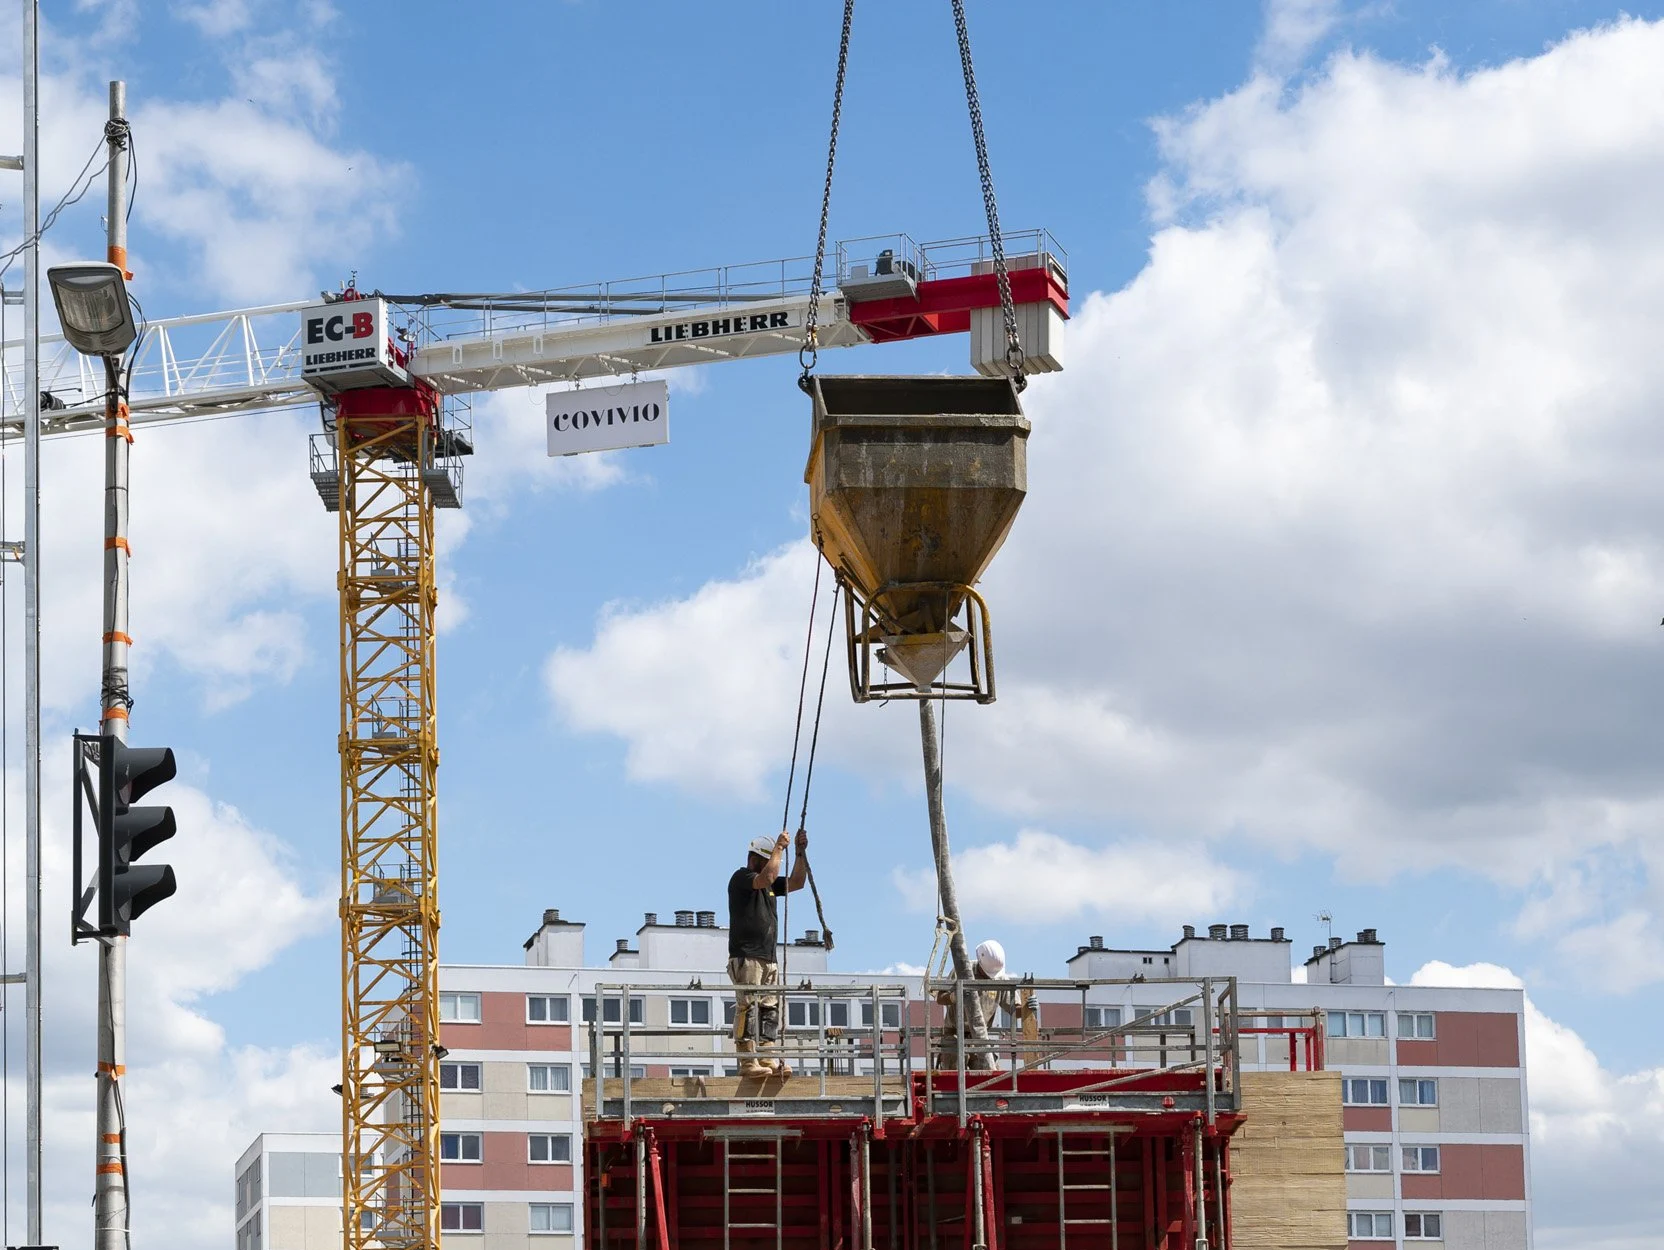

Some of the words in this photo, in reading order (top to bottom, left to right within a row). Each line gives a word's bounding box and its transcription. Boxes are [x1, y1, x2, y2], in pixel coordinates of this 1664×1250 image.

[307, 312, 374, 344] EC-B
[650, 311, 790, 343] LIEBHERR
[306, 347, 376, 366] LIEBHERR
[553, 402, 660, 432] COVIVIO
[746, 1100, 774, 1108] HUSSOR
[1080, 1094, 1107, 1102] HUSSOR
